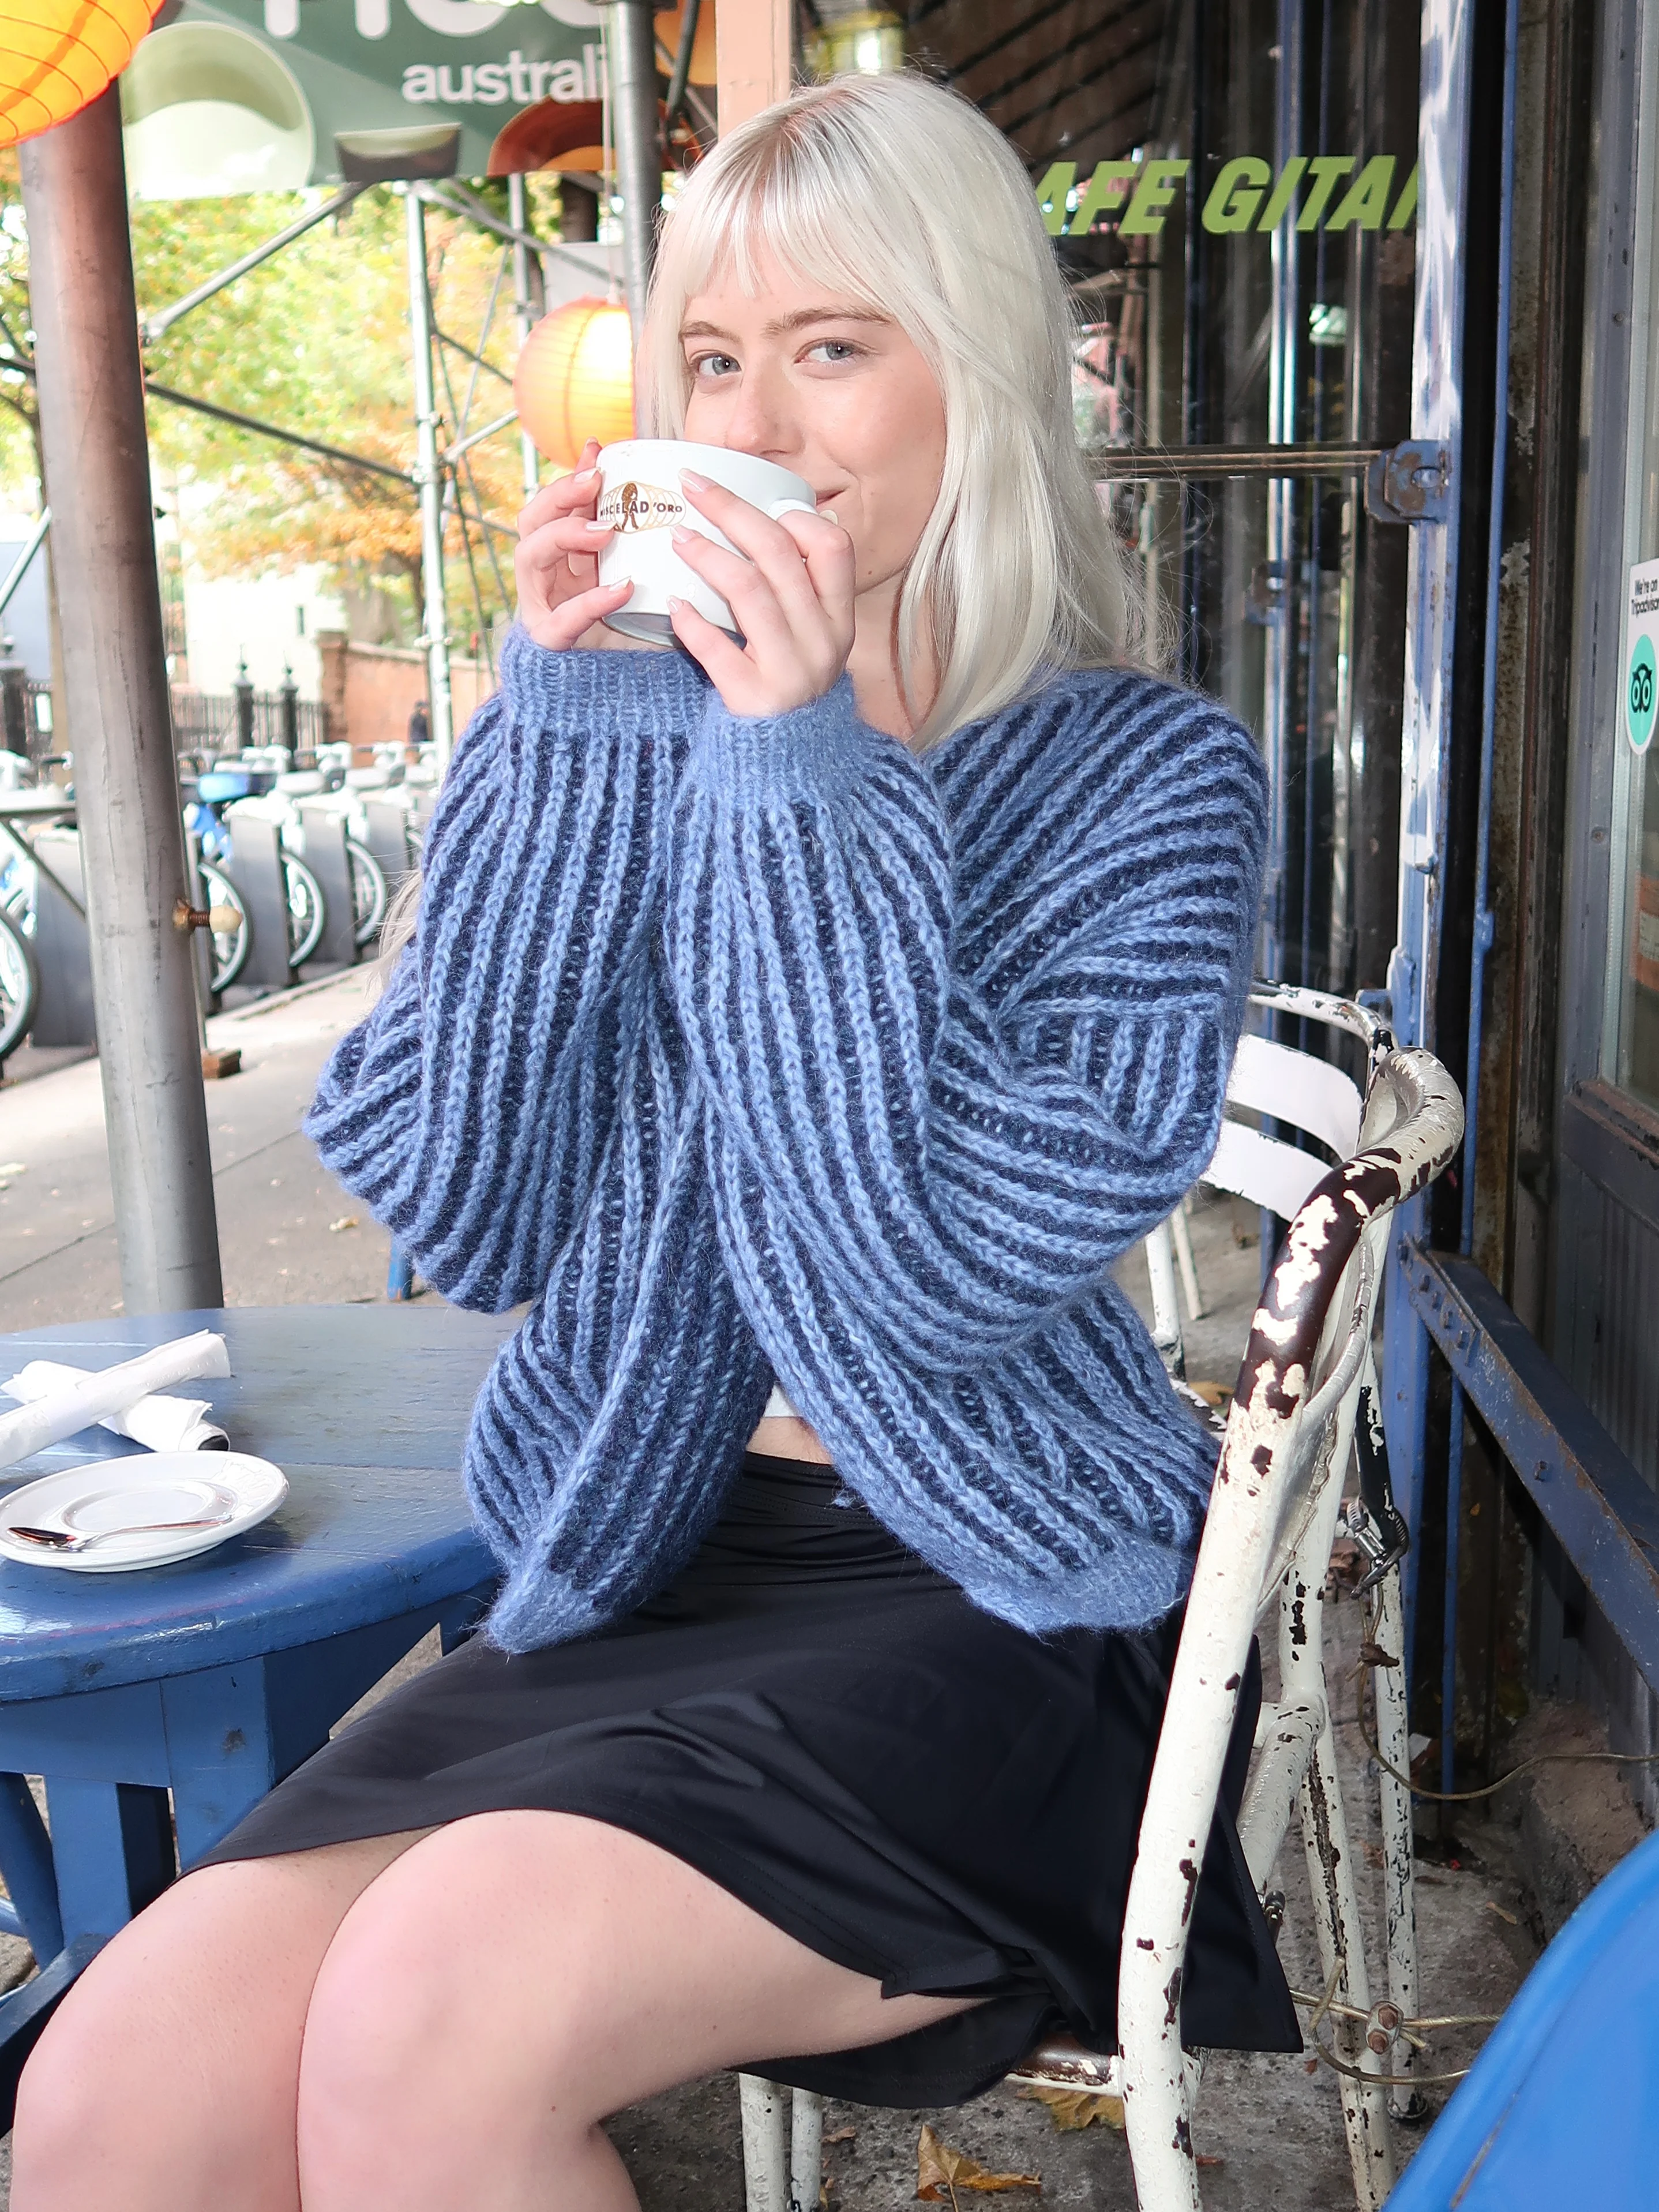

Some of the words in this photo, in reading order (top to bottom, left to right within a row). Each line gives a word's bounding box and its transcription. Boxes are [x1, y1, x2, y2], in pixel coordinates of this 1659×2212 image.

[401, 44, 609, 104] australi
[1035, 159, 1191, 235] AFE
[1631, 594, 1659, 618] Tripadviso
[1651, 579, 1657, 592] on
